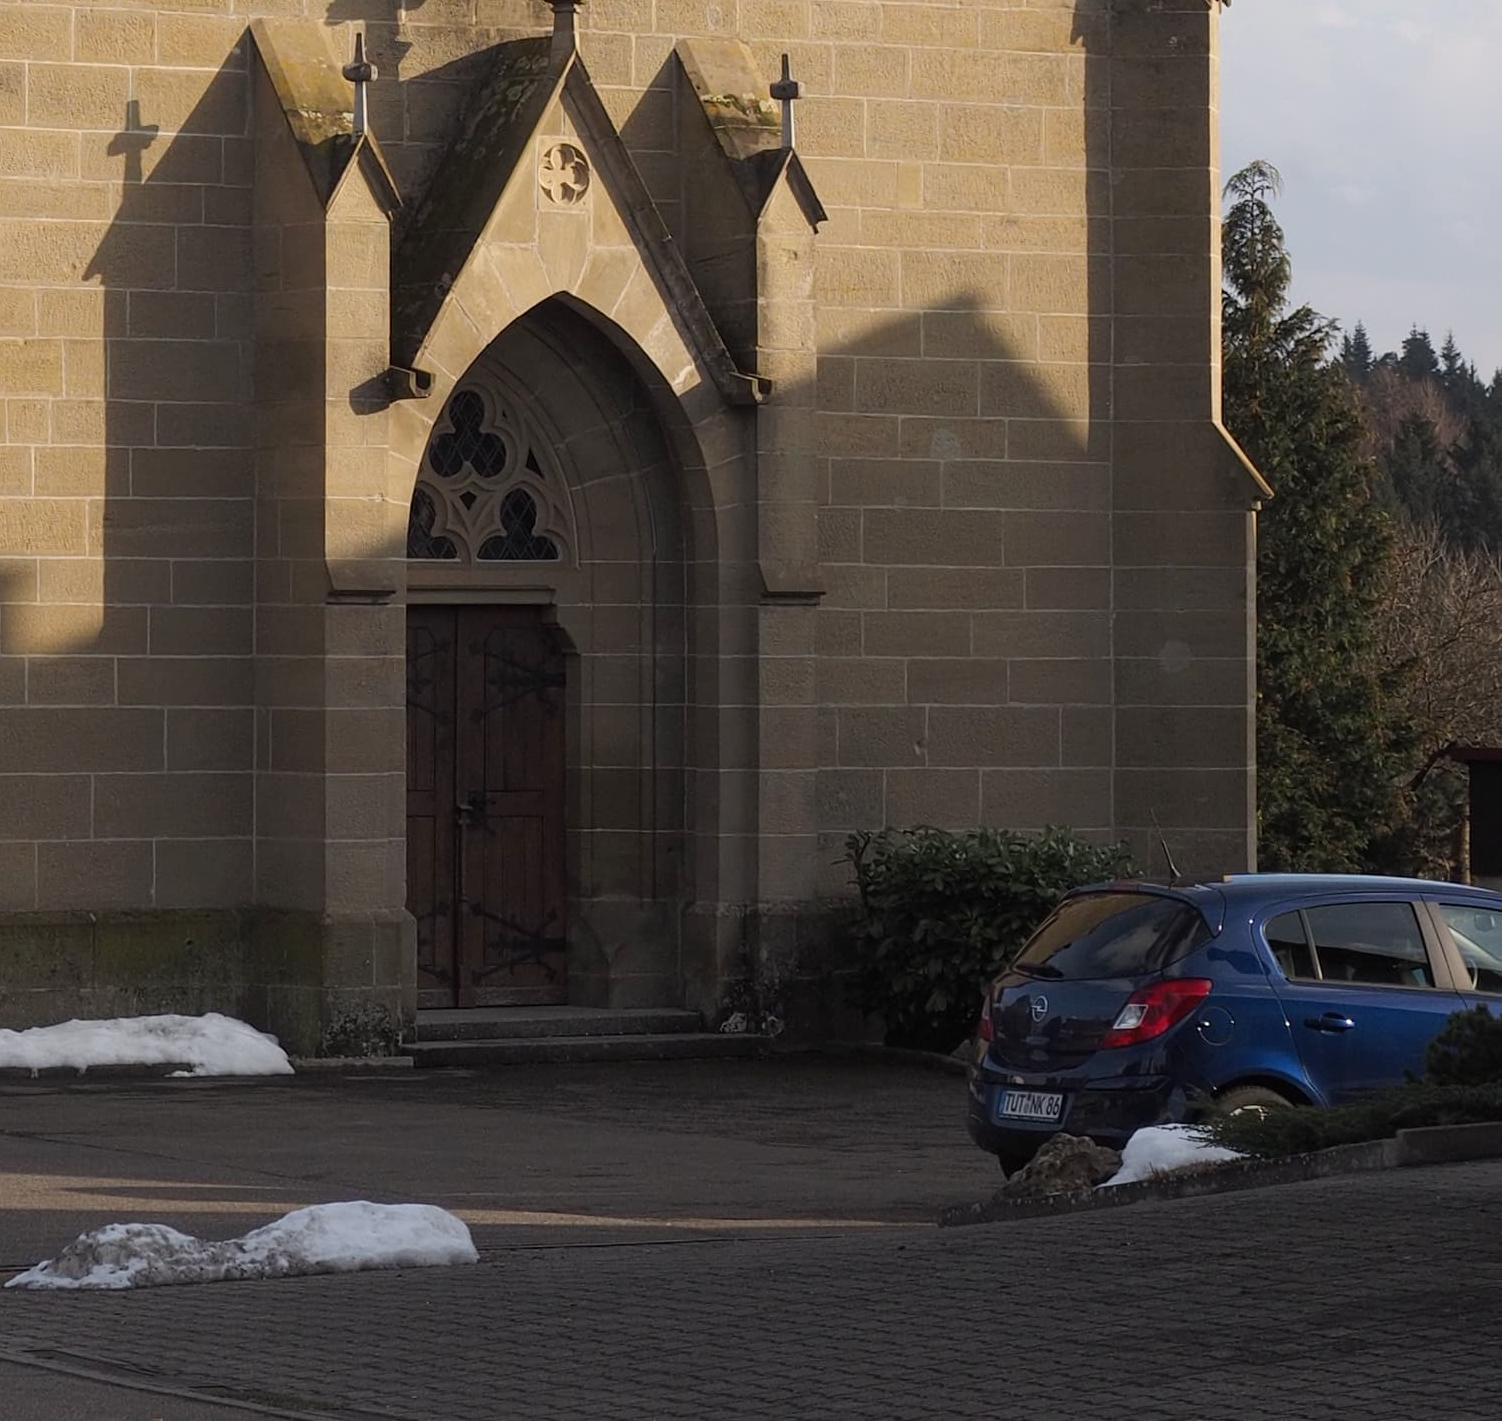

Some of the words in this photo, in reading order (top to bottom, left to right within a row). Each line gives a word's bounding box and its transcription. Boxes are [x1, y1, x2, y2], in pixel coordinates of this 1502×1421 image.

[1005, 1093, 1027, 1112] TUT
[1029, 1094, 1046, 1115] NK
[1046, 1096, 1060, 1116] 86
